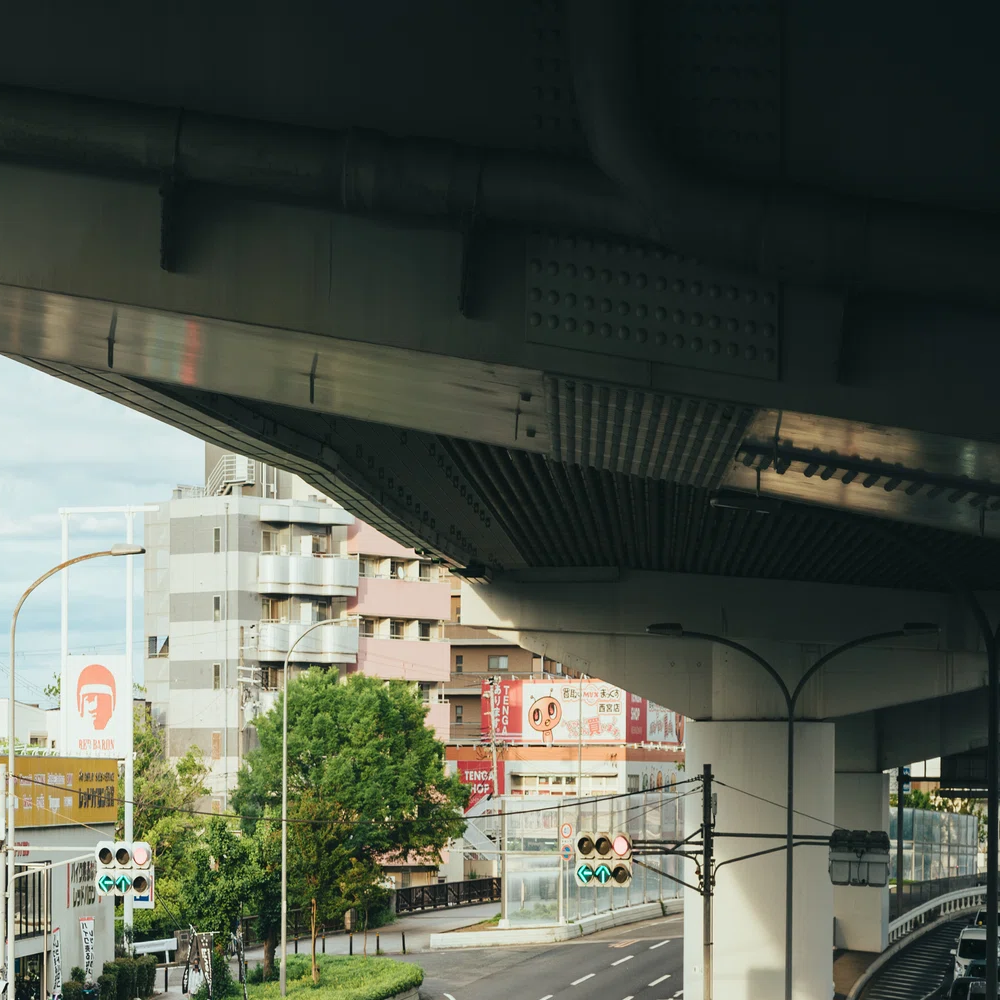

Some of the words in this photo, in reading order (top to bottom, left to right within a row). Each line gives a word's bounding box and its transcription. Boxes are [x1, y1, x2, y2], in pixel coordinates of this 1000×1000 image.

[501, 685, 510, 735] TENGA
[599, 703, 620, 713] 西宮店
[92, 738, 115, 750] BARON
[464, 770, 495, 781] TENGA
[471, 783, 490, 794] HOP
